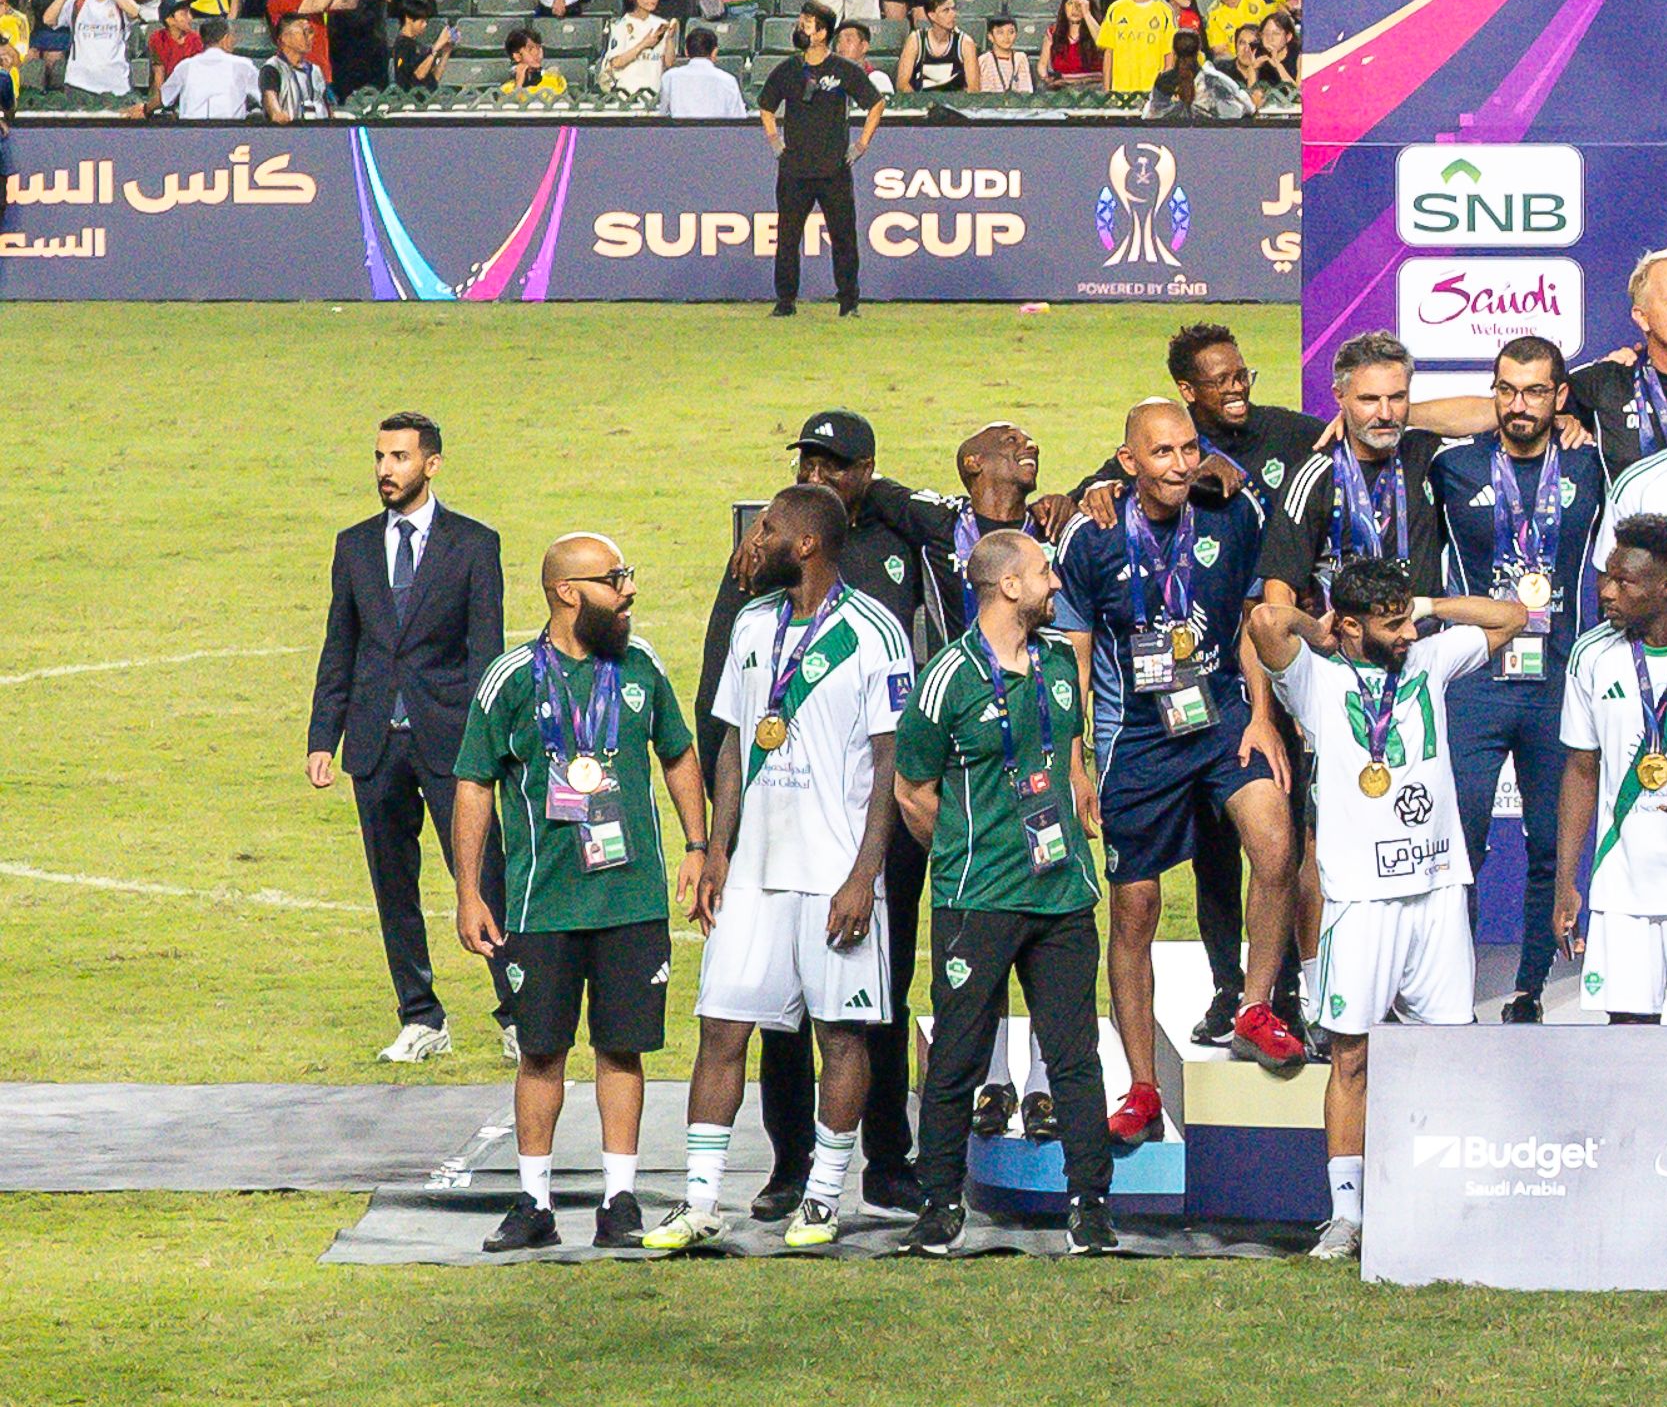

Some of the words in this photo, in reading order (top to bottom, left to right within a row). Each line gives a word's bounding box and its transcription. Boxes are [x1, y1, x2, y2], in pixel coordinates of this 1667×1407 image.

[123, 144, 317, 213] كأس
[872, 167, 1023, 200] SAUDI
[1413, 193, 1567, 233] SNB
[868, 211, 1027, 258] CUP
[1077, 283, 1146, 295] POWERED
[1147, 283, 1164, 295] BY
[1167, 283, 1208, 295] SNB
[1418, 271, 1562, 325] Saudi
[1470, 323, 1538, 336] Welcome
[1464, 1135, 1599, 1178] Budget
[1465, 1180, 1510, 1197] Saudi
[1512, 1180, 1567, 1197] Arabia
